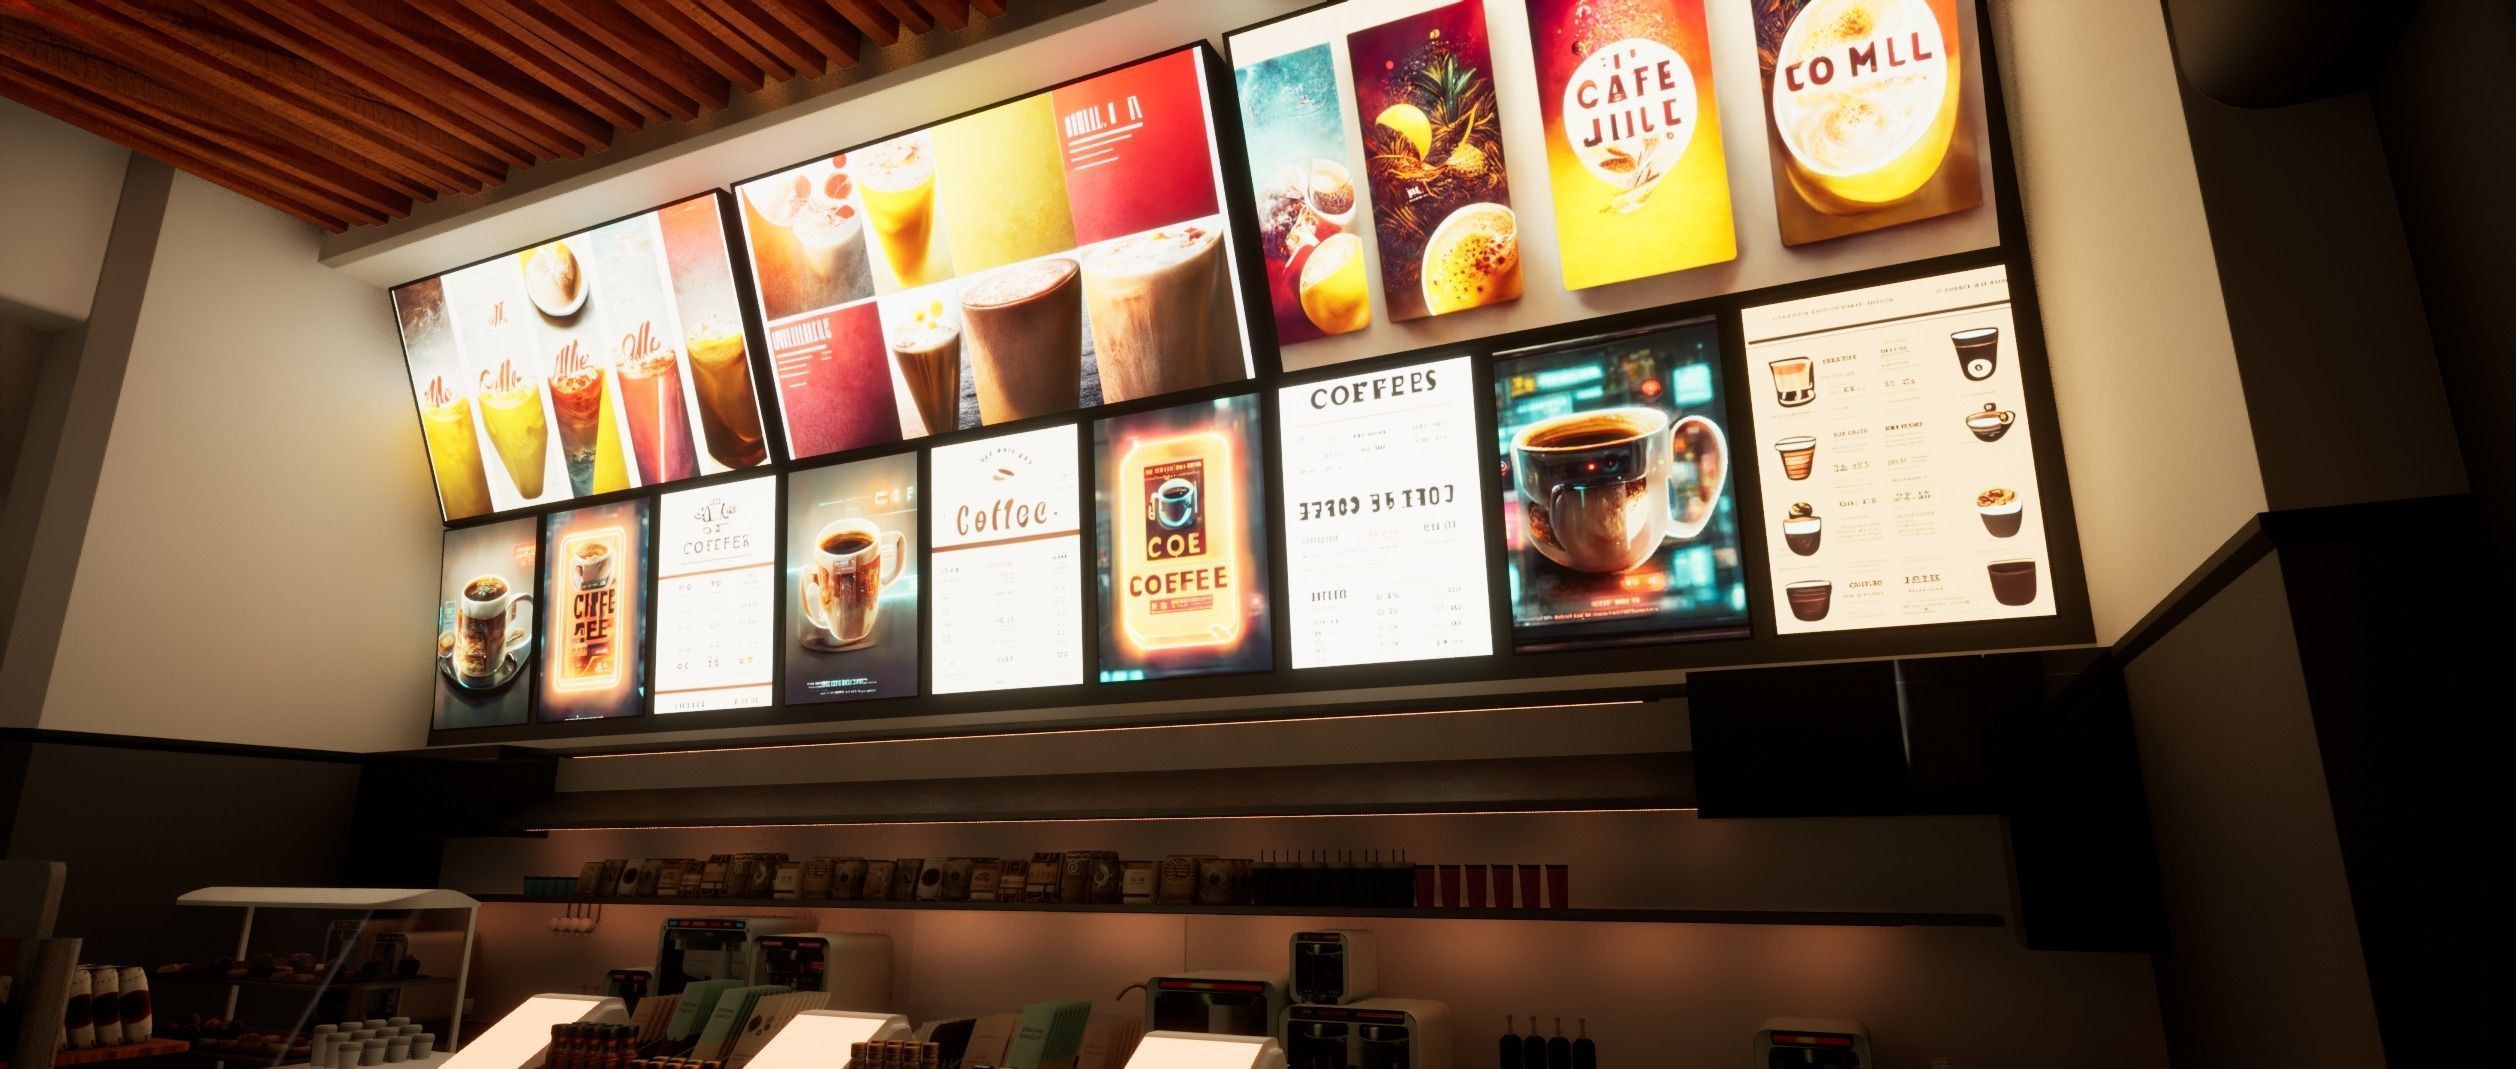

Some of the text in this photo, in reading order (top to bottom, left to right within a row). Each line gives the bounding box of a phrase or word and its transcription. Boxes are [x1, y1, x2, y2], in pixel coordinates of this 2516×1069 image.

[1577, 60, 1676, 109] CAFE
[1147, 534, 1201, 559] COE
[1129, 566, 1229, 597] COFFEE
